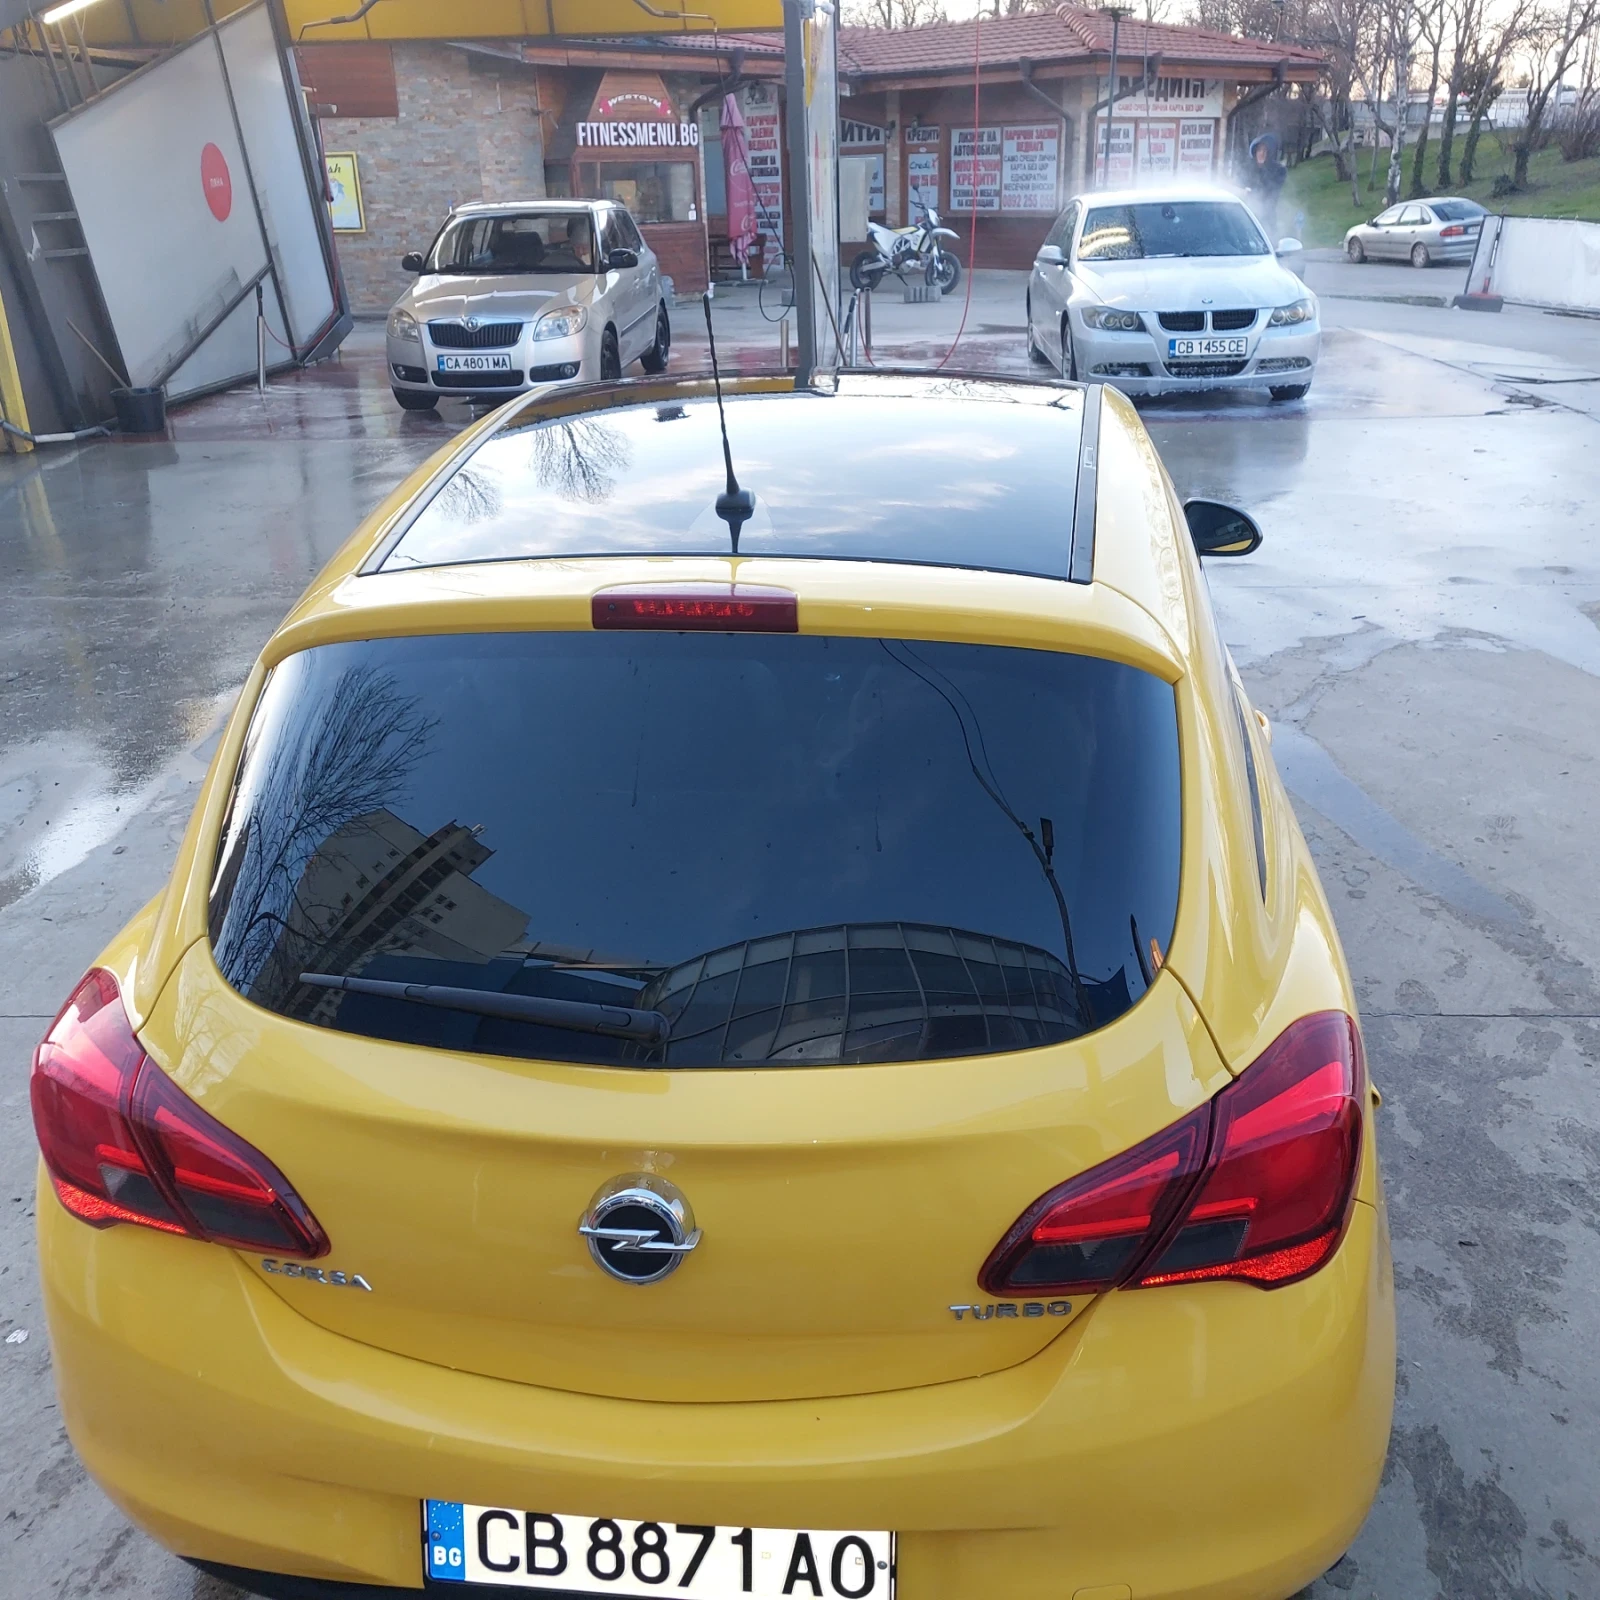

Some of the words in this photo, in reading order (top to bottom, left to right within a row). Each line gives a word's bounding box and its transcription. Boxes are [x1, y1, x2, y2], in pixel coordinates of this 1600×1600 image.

[608, 93, 662, 108] WESTGYM
[576, 122, 699, 147] FITNESSMENU.BG
[841, 119, 880, 142] ИТИ
[986, 131, 997, 142] НА
[953, 144, 1001, 156] АВТОМОБИЛИ
[328, 163, 342, 173] sh
[956, 173, 998, 186] КРЕДИТИ
[1177, 341, 1194, 354] CB
[1198, 340, 1226, 354] 1455
[1228, 339, 1245, 353] CE
[445, 357, 462, 370] CA
[463, 357, 490, 369] 4801
[492, 357, 509, 369] MA
[261, 1258, 373, 1291] CORSA
[948, 1300, 1073, 1321] TURBO
[433, 1545, 462, 1567] BG
[477, 1509, 568, 1577] CB
[586, 1518, 753, 1593] 8871
